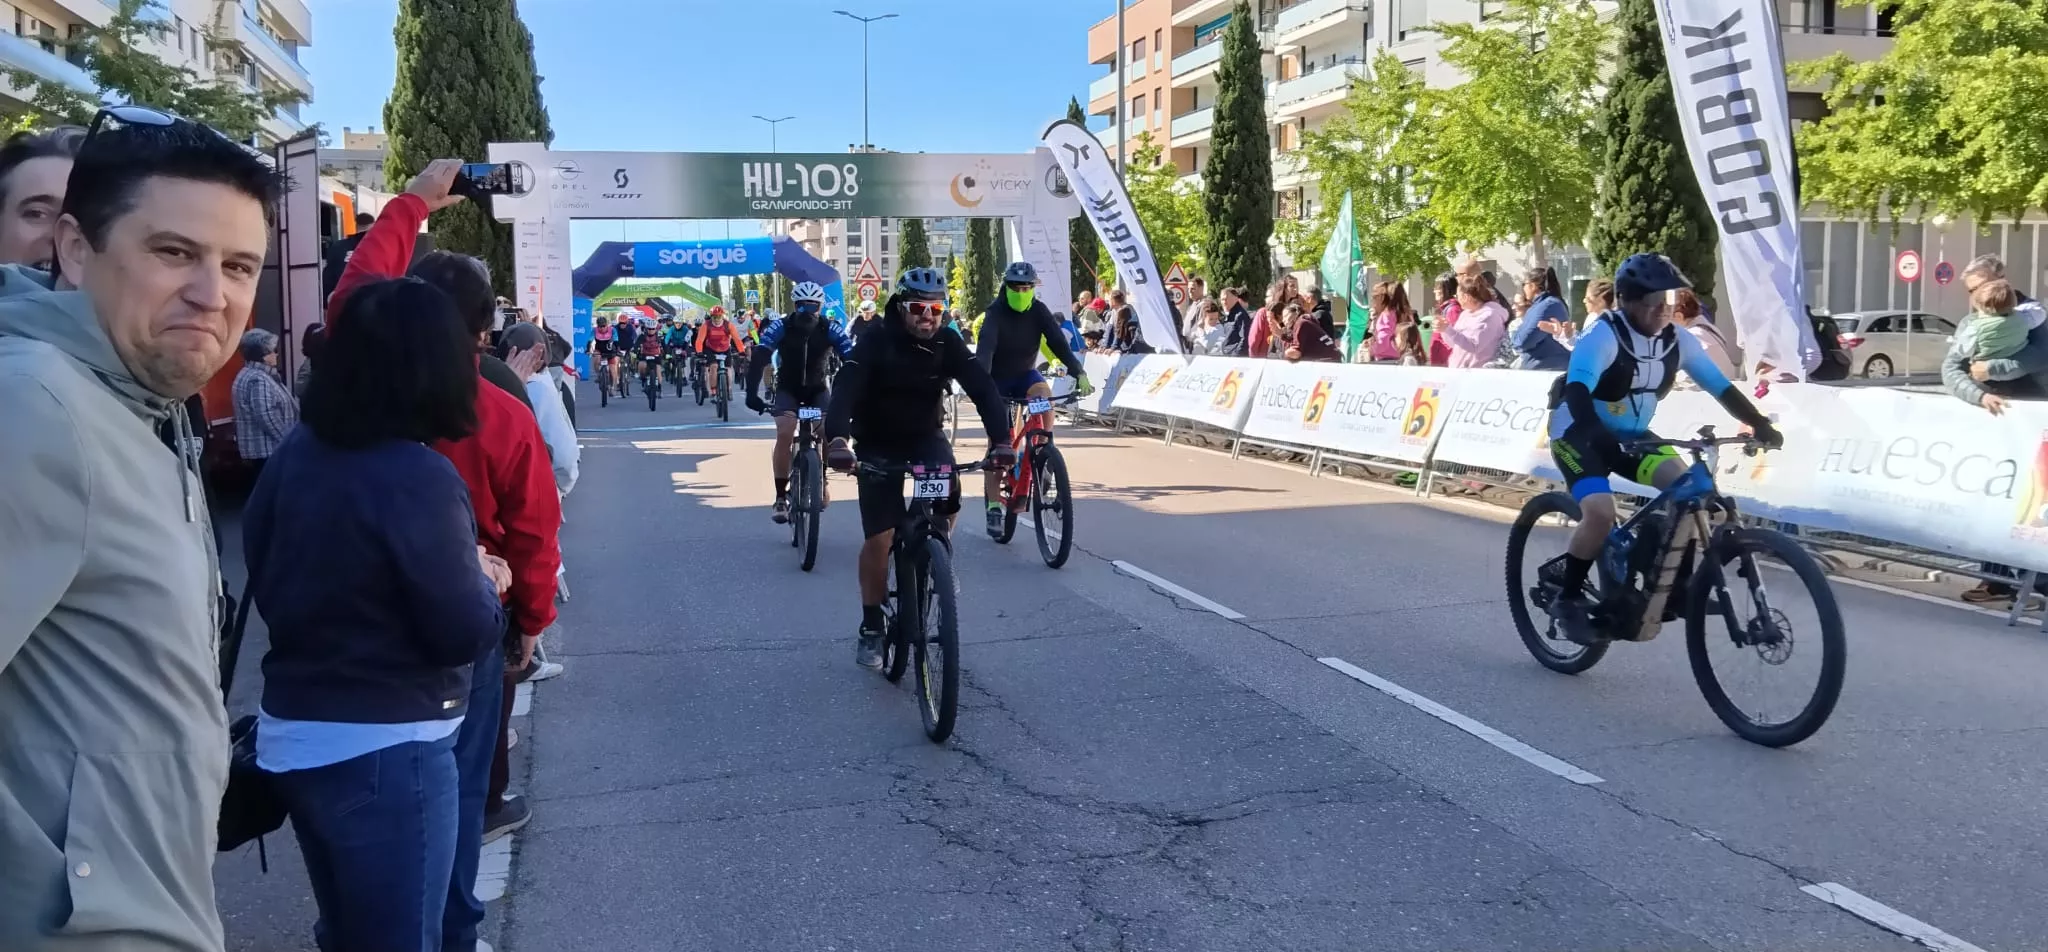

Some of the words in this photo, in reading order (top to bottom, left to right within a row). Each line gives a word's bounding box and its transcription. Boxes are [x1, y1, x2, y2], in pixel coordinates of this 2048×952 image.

[1680, 7, 1782, 235] GOBIK
[920, 483, 943, 493] 930
[1818, 435, 2018, 500] Huesca
